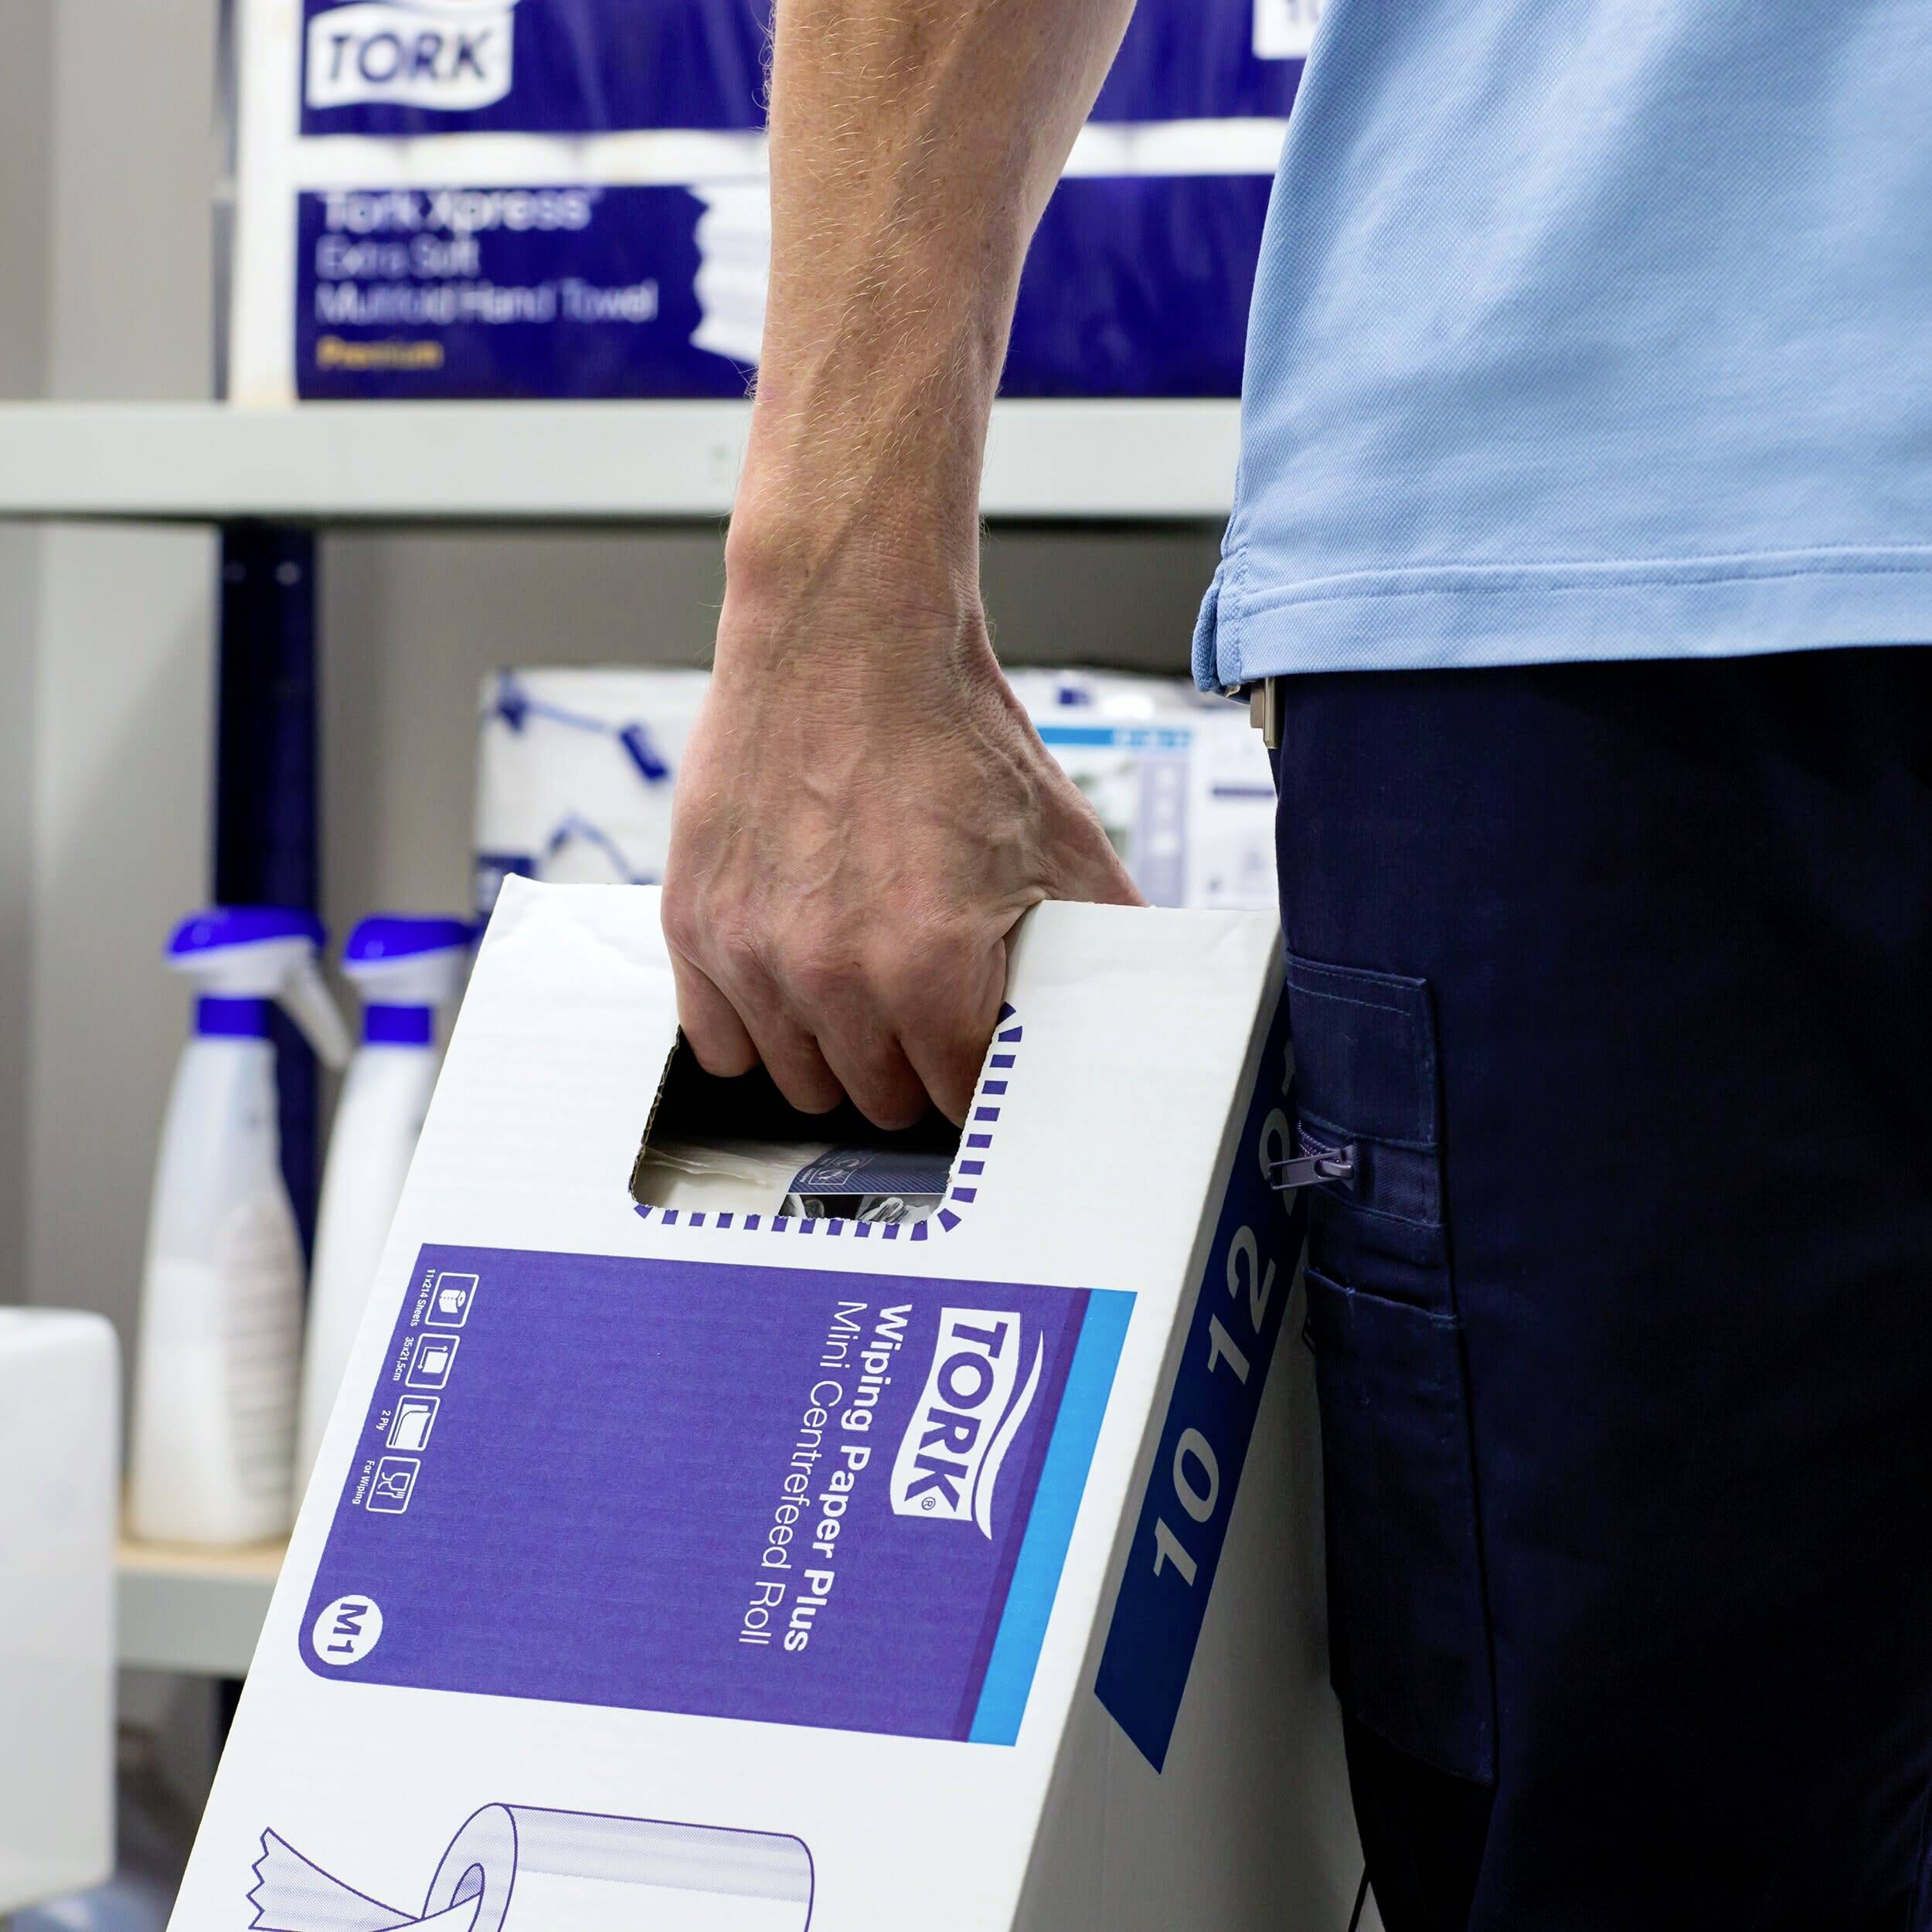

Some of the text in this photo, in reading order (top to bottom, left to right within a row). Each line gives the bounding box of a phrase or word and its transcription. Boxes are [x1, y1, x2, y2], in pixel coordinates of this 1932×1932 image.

[329, 29, 490, 83] TORK
[424, 191, 592, 237] Xpress
[316, 234, 479, 278] Extra Soft
[459, 280, 556, 324] Hand
[563, 277, 658, 323] Towel
[410, 1269, 436, 1327] 11x214 Sheets
[393, 1336, 415, 1381] 35x21,5cm
[376, 1417, 389, 1430] Ply
[1152, 1427, 1219, 1587] 10
[1206, 1225, 1277, 1385] 12
[352, 1460, 376, 1505] For Wiping
[739, 1301, 869, 1645] Mini Centrefeed Roll
[783, 1304, 913, 1652] Wiping Paper Plus
[326, 1602, 369, 1653] M1
